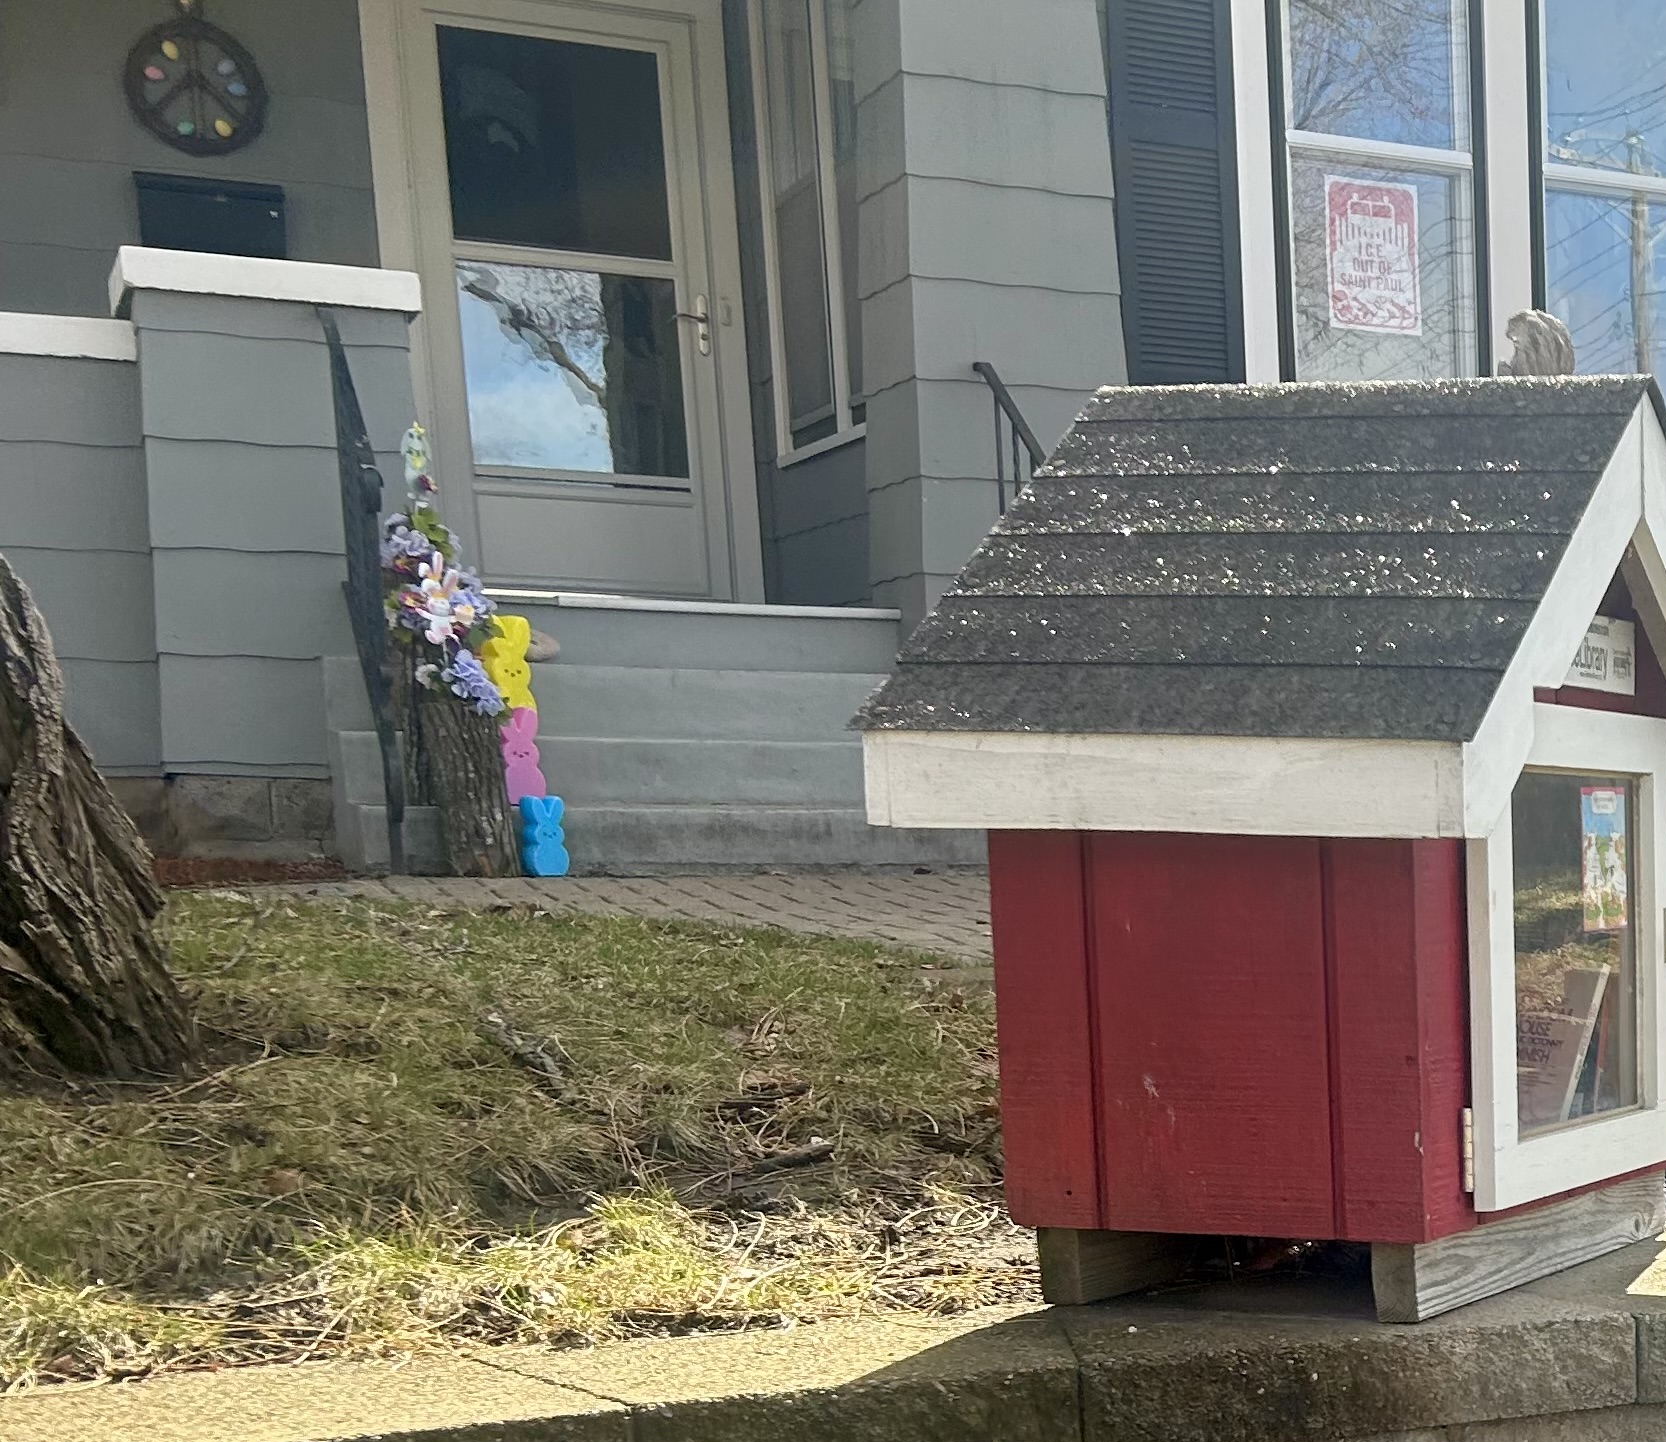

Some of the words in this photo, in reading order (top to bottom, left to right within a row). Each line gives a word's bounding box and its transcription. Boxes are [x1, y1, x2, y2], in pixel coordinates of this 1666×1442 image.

[1352, 258, 1374, 273] OUT
[1378, 260, 1393, 275] OF
[1340, 272, 1372, 289] SAINT
[1376, 275, 1404, 293] PAUL
